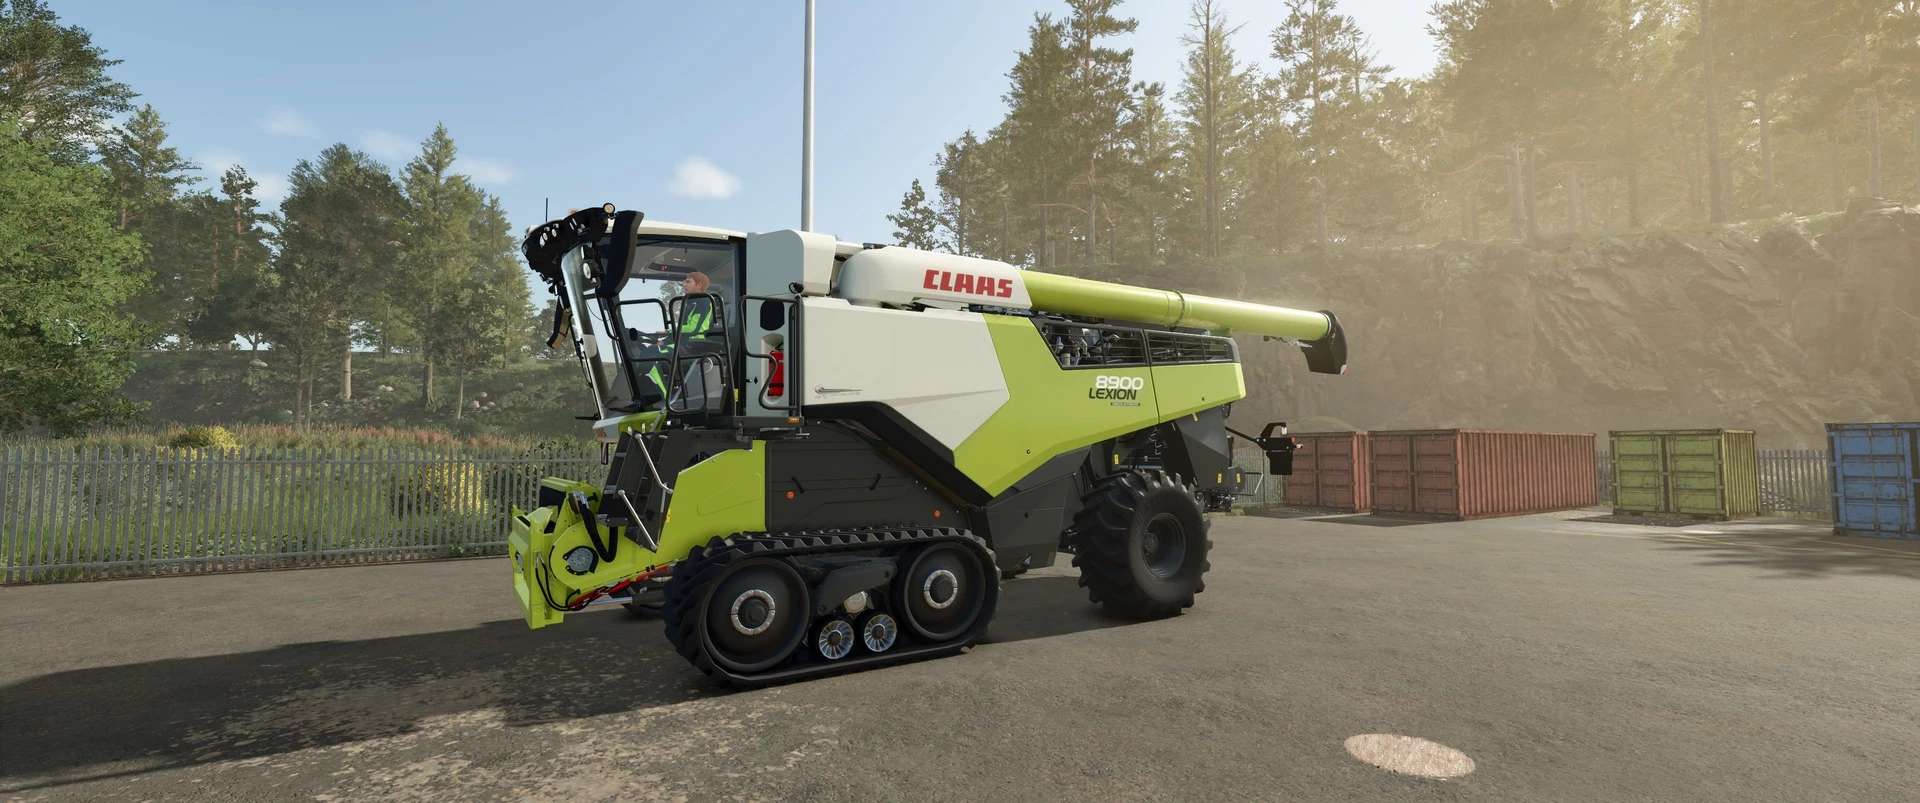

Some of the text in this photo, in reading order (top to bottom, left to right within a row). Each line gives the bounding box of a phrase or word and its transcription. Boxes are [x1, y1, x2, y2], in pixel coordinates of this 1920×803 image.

[923, 269, 1013, 298] CLAAS
[1095, 375, 1144, 390] 8900
[1088, 387, 1137, 400] LEXION
